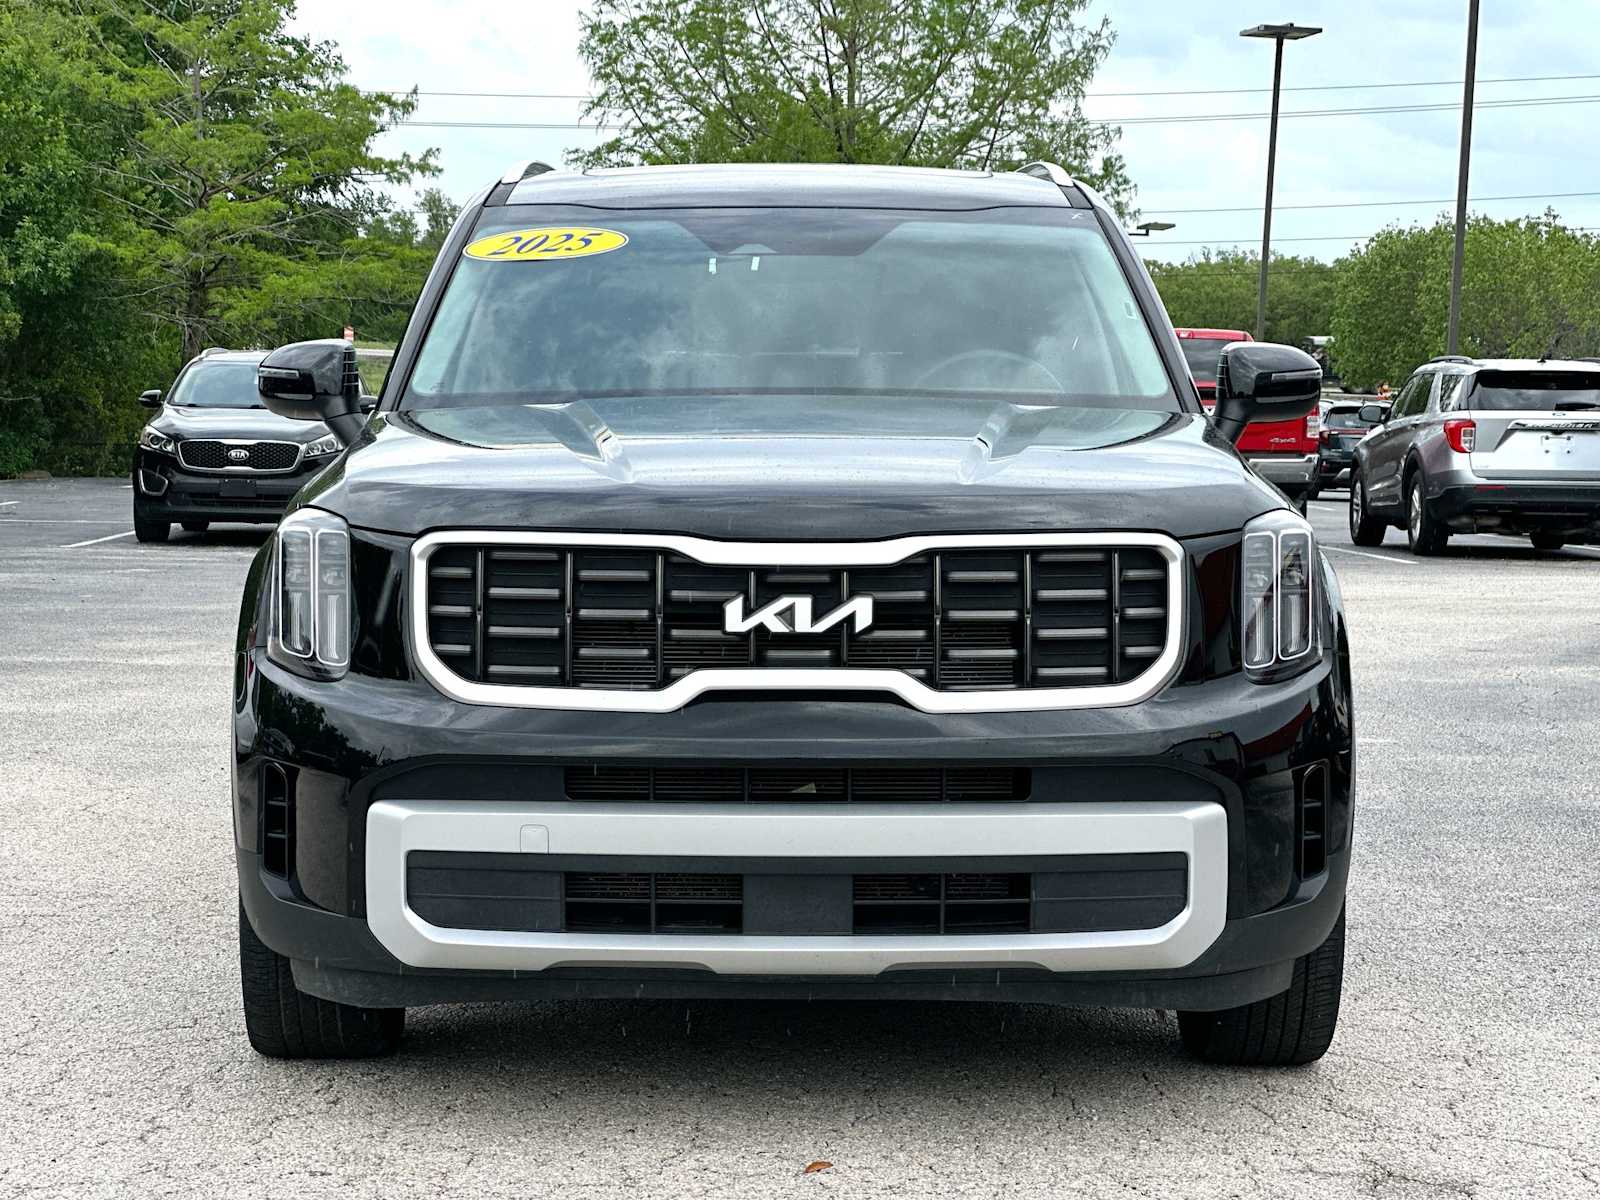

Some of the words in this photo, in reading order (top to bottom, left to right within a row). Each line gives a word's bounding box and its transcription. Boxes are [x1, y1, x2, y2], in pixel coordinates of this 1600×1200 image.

[486, 232, 603, 256] 2025
[230, 450, 247, 459] KIA
[723, 594, 874, 633] KIA
